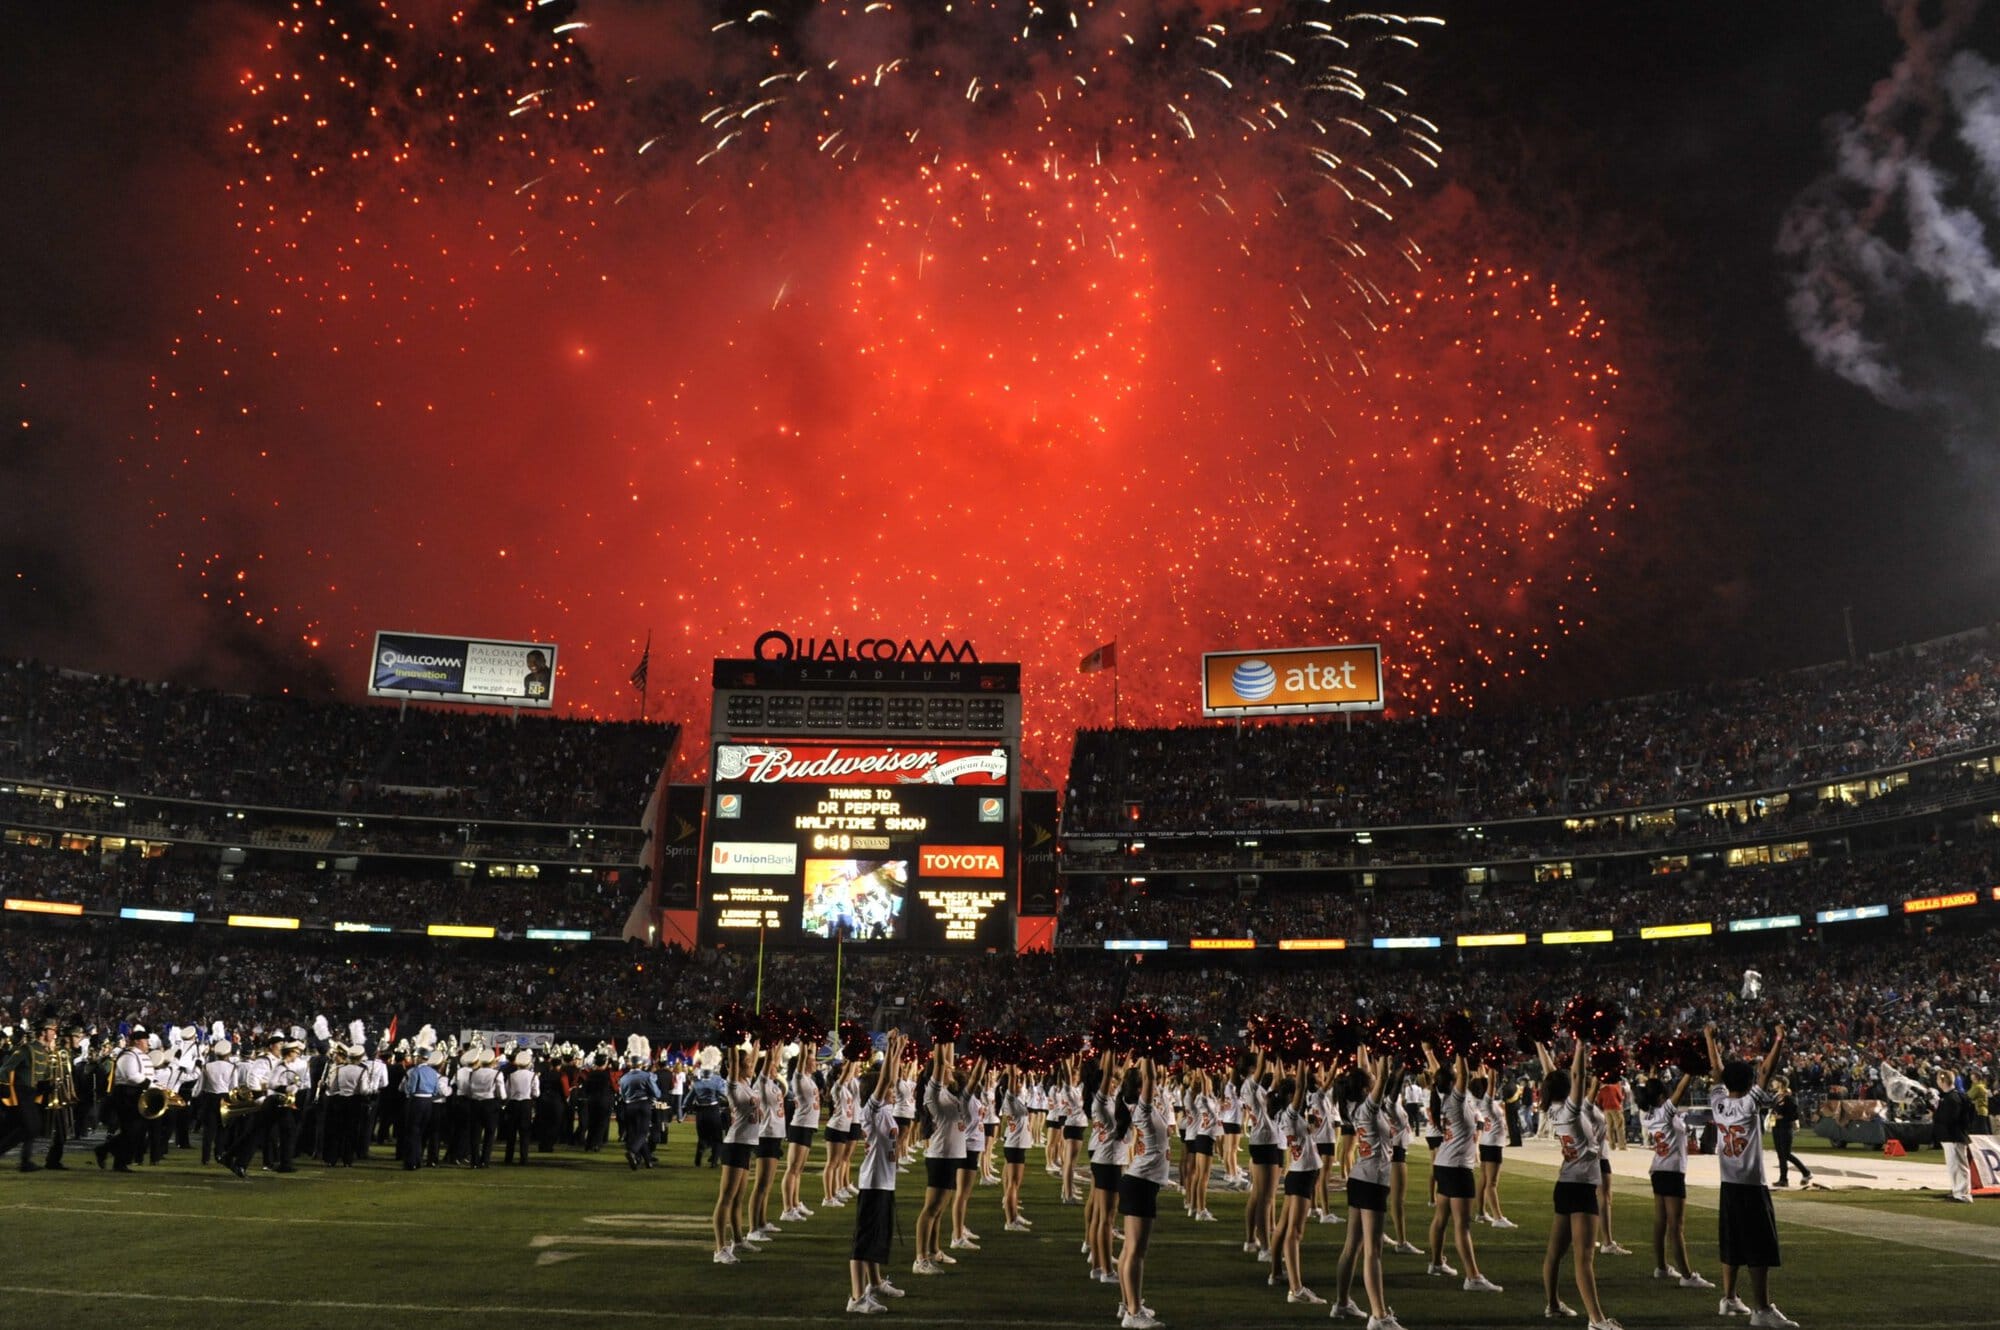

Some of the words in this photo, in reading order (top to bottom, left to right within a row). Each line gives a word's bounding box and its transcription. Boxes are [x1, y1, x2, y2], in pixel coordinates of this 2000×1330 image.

[471, 647, 525, 658] PALOMAR
[754, 630, 981, 662] QUALCOMM
[381, 651, 461, 668] QUALCOMM
[395, 668, 447, 680] Innovation
[469, 666, 524, 677] HEALTH
[801, 669, 960, 681] STADIUM
[1284, 660, 1357, 692] at&t
[743, 747, 938, 783] Budweiser
[939, 760, 978, 779] American
[829, 788, 872, 800] THANKS
[876, 789, 892, 800] TO
[818, 801, 839, 814] DR
[844, 802, 900, 815] PEPPER
[795, 816, 876, 829] HALFTIME
[885, 817, 926, 830] SHOW
[734, 853, 794, 864] UnionBank
[923, 854, 1000, 870] TOYOTA
[919, 891, 936, 899] THE
[939, 891, 979, 899] PACIFIC
[982, 892, 1006, 900] LIFE
[1907, 896, 1940, 911] WELLS
[1941, 893, 1978, 908] FARGO
